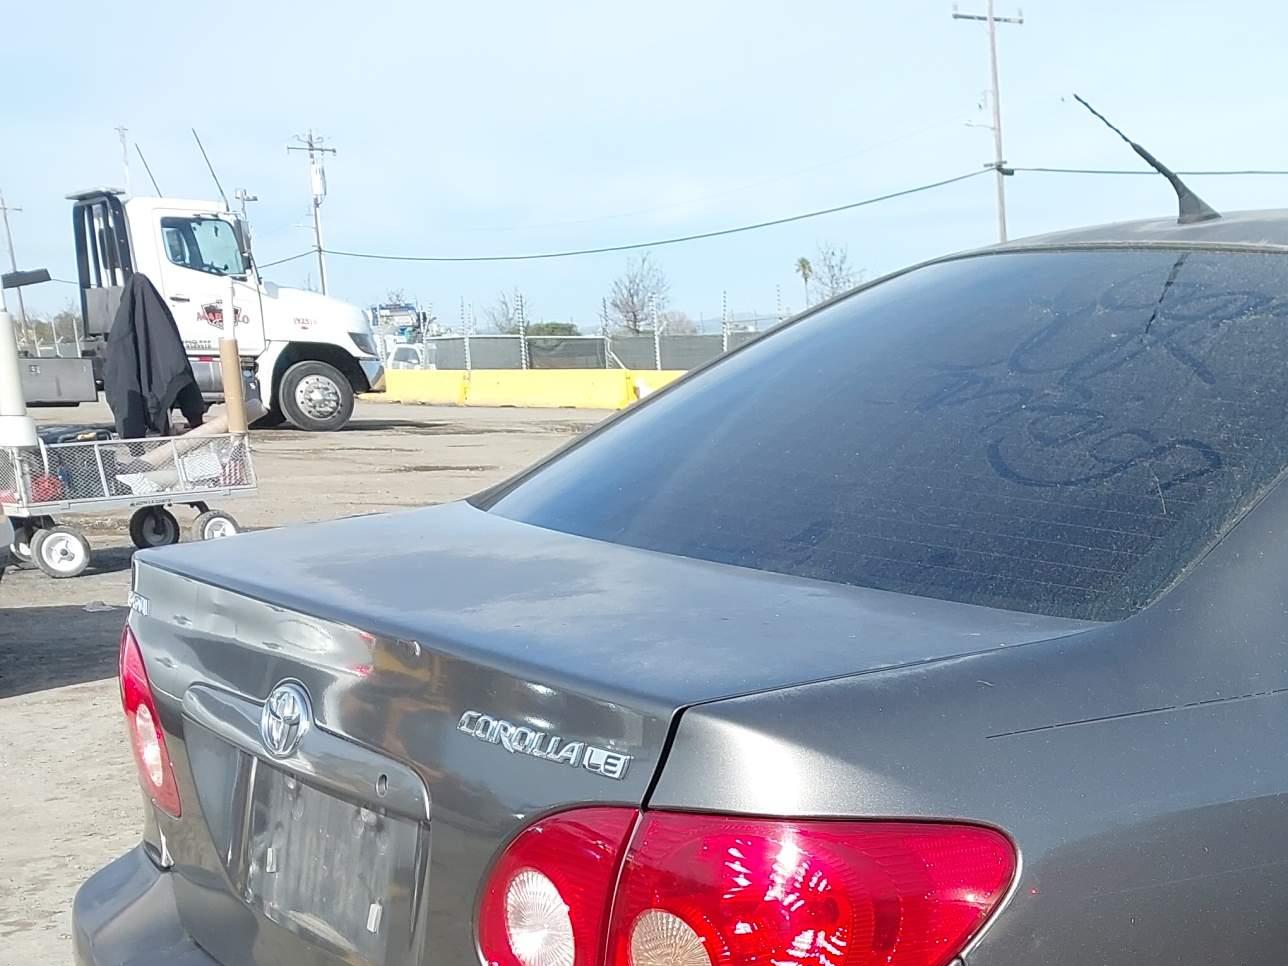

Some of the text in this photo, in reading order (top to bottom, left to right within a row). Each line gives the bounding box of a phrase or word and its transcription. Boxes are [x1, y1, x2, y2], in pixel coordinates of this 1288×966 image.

[197, 311, 250, 324] MARLO
[456, 709, 633, 781] COROLLA LE
